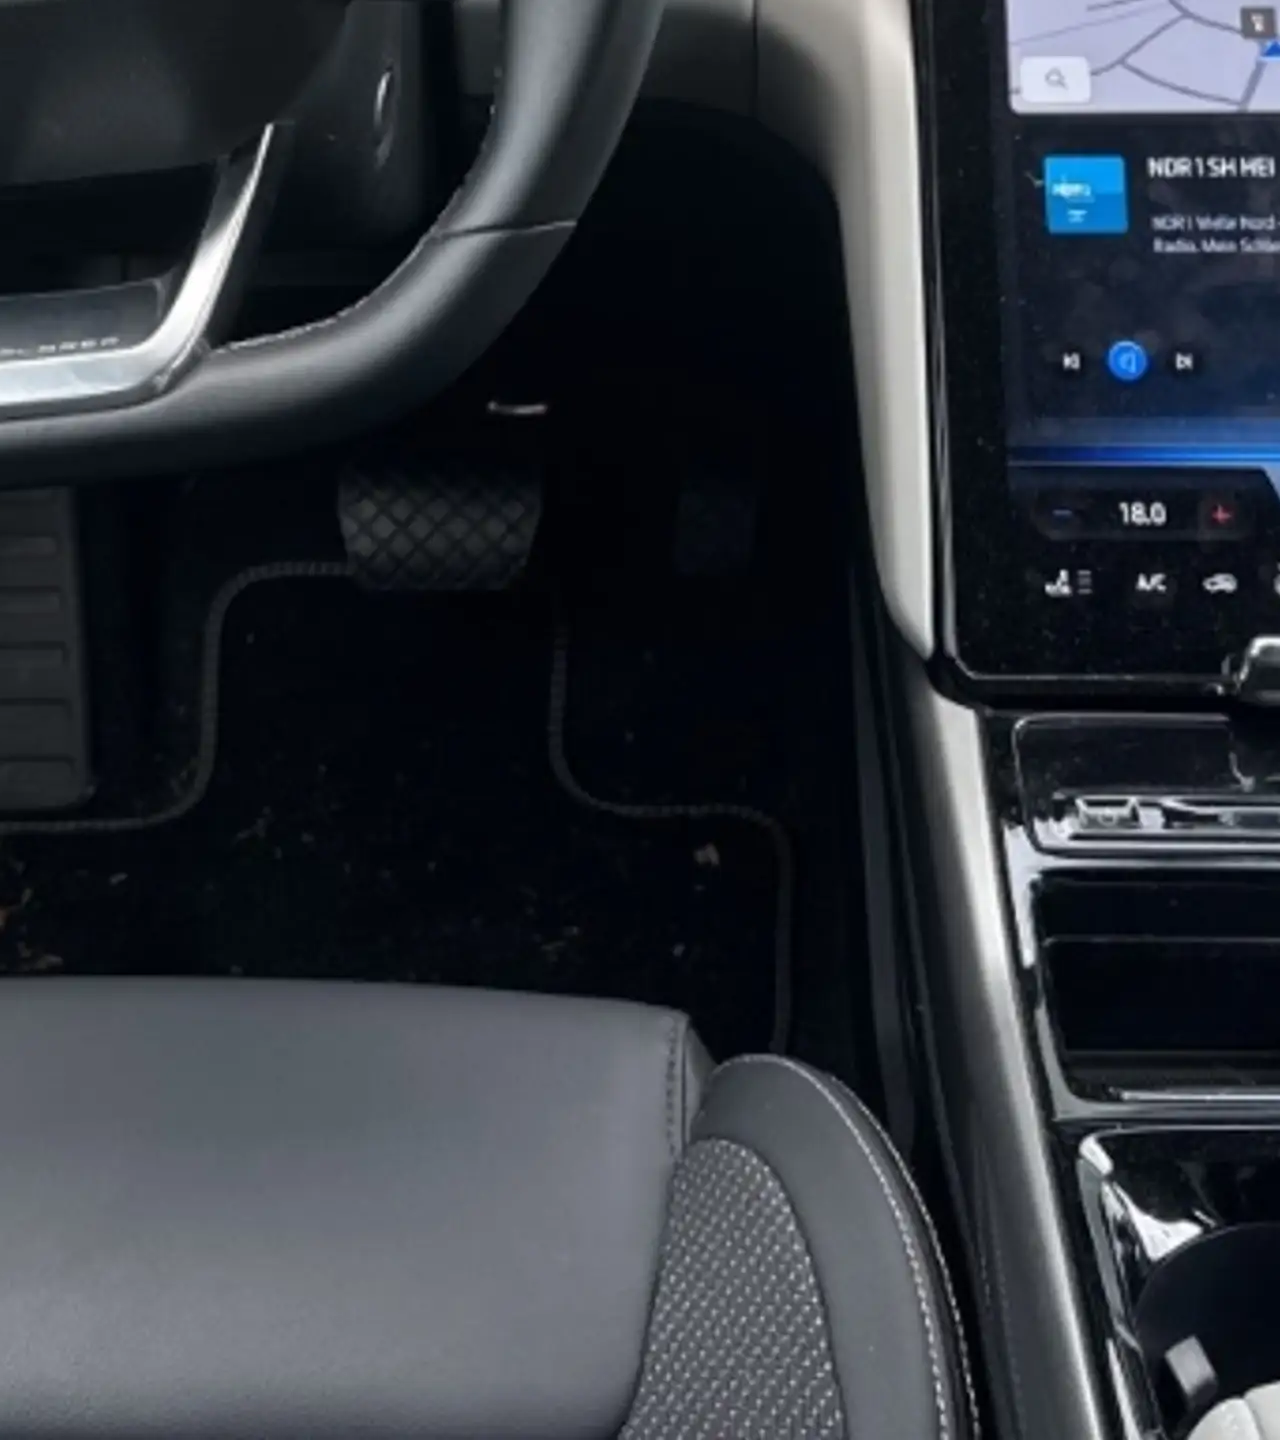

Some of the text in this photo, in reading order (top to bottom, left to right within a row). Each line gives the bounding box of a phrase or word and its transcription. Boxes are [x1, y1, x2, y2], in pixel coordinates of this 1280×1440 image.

[1147, 156, 1192, 178] NDR
[1206, 156, 1238, 178] SH
[1118, 501, 1168, 527] 18.0
[1135, 572, 1168, 594] A/C
